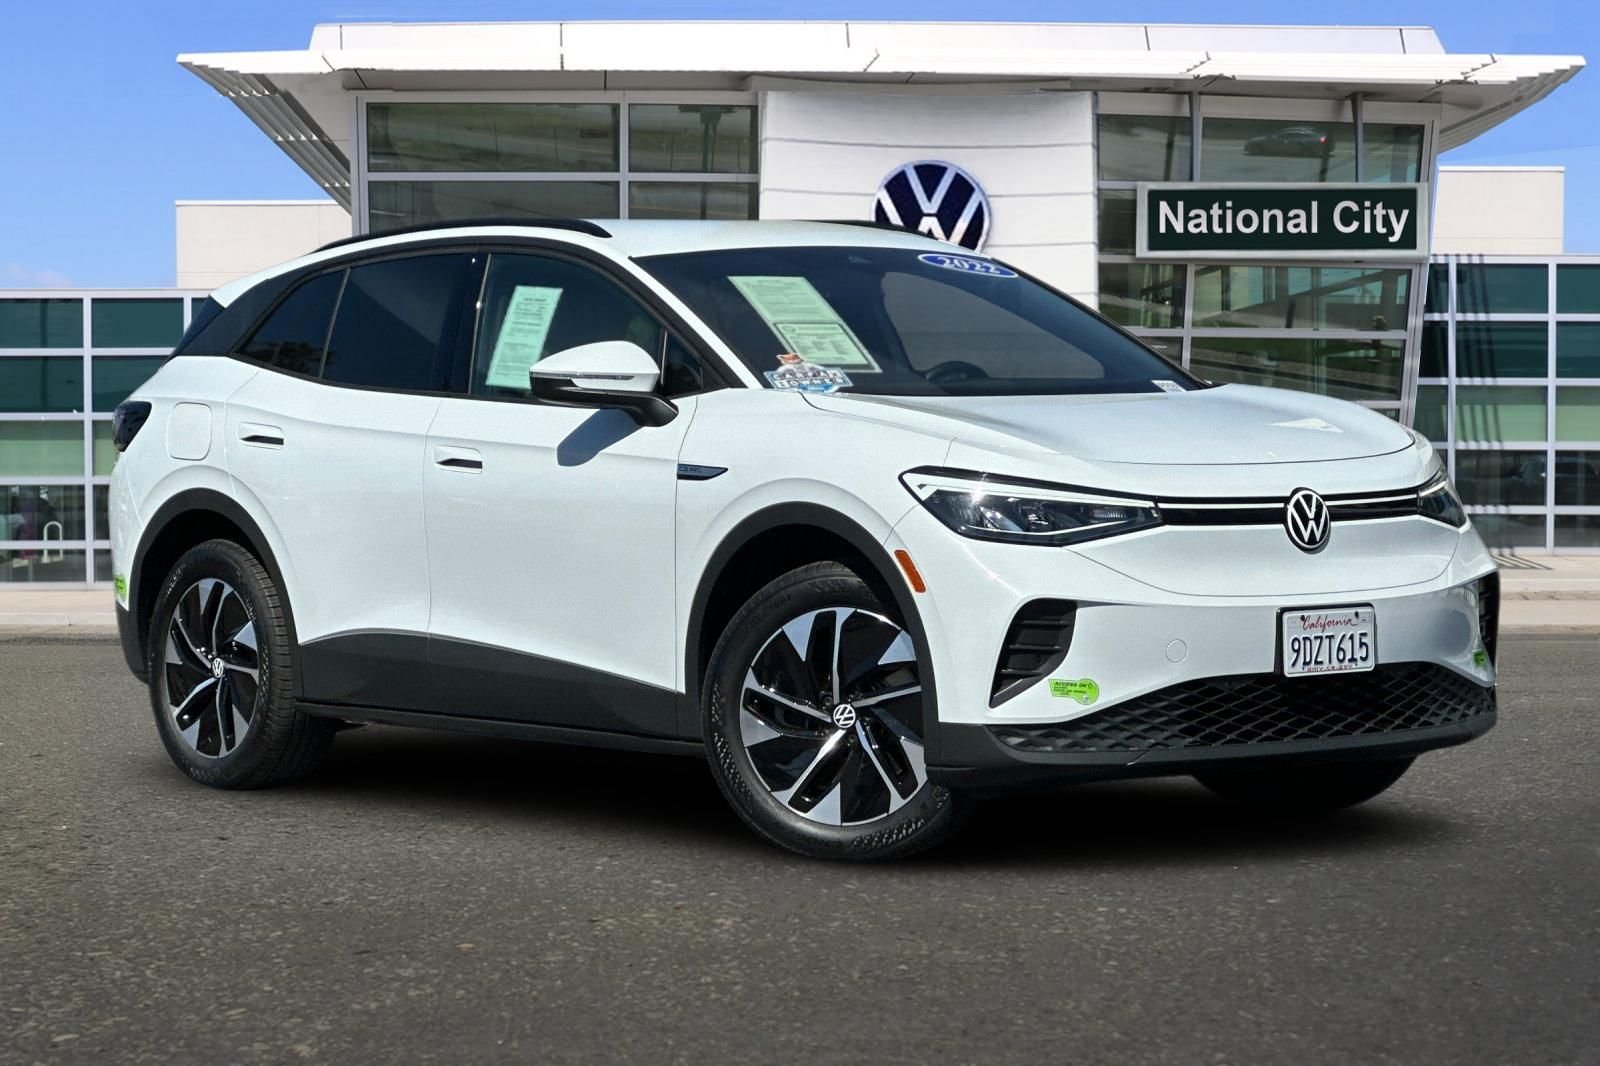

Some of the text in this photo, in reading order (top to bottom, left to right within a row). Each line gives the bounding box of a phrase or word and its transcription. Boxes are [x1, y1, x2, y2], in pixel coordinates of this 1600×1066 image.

[1158, 200, 1410, 243] National City
[937, 256, 1001, 274] 2022
[1302, 612, 1358, 633] California
[1291, 632, 1369, 668] 9DZT615
